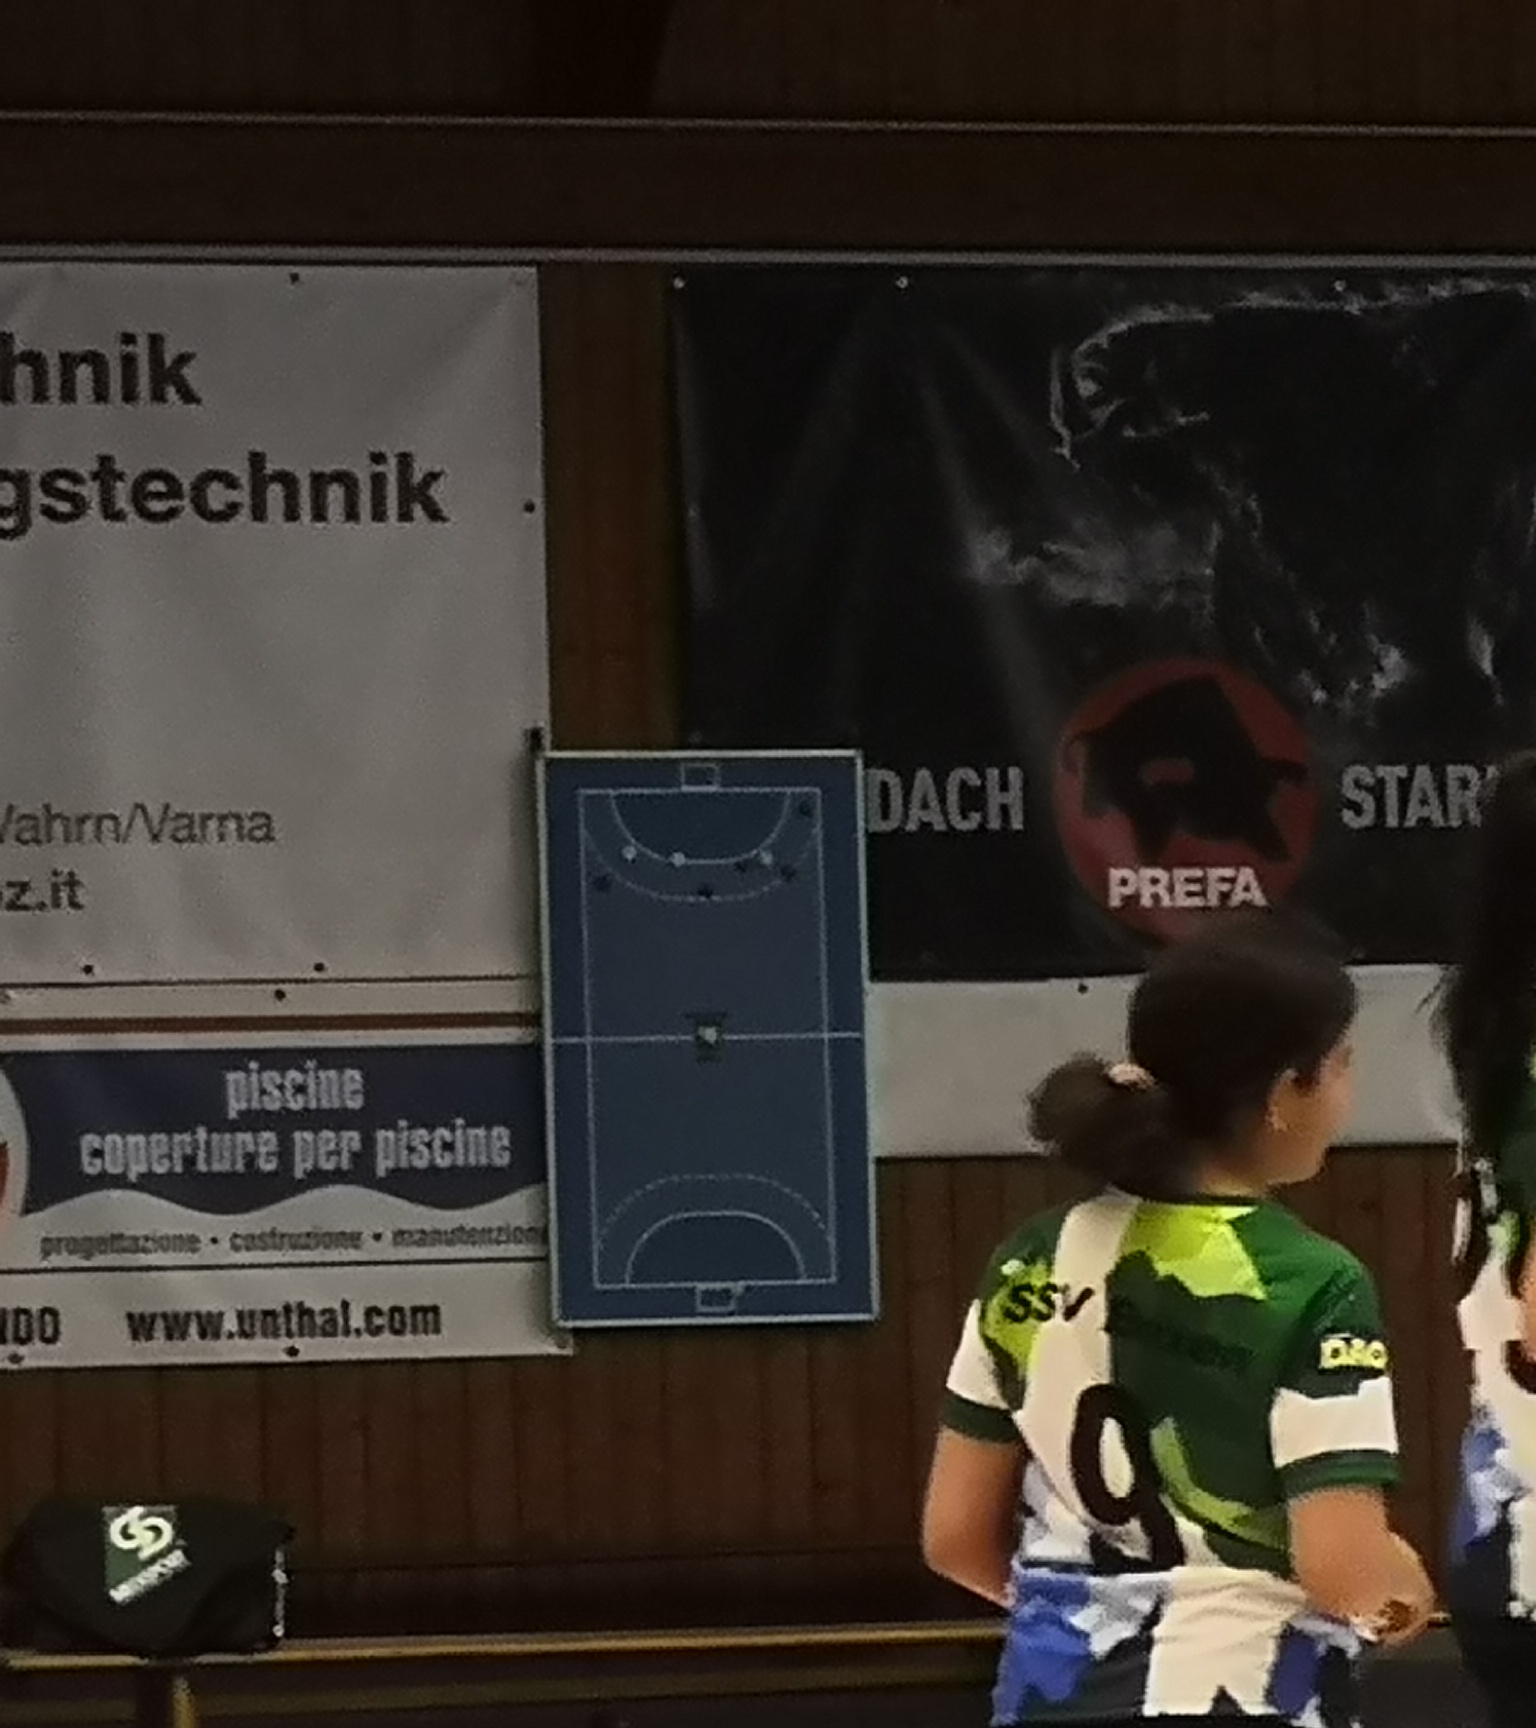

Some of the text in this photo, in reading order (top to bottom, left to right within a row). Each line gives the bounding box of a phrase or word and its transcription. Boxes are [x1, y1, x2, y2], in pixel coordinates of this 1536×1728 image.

[0, 331, 202, 406] hnik
[0, 449, 451, 541] gstechnik
[866, 766, 1024, 832] DACH
[1340, 763, 1500, 830] STAR
[0, 867, 84, 912] z.it
[1107, 866, 1268, 909] PREFA
[225, 1059, 365, 1120] piscine
[79, 1117, 511, 1184] coperture per piscine
[126, 1299, 442, 1344] www.unthal.com
[1002, 1281, 1097, 1323] SSV
[1069, 1381, 1186, 1575] 9
